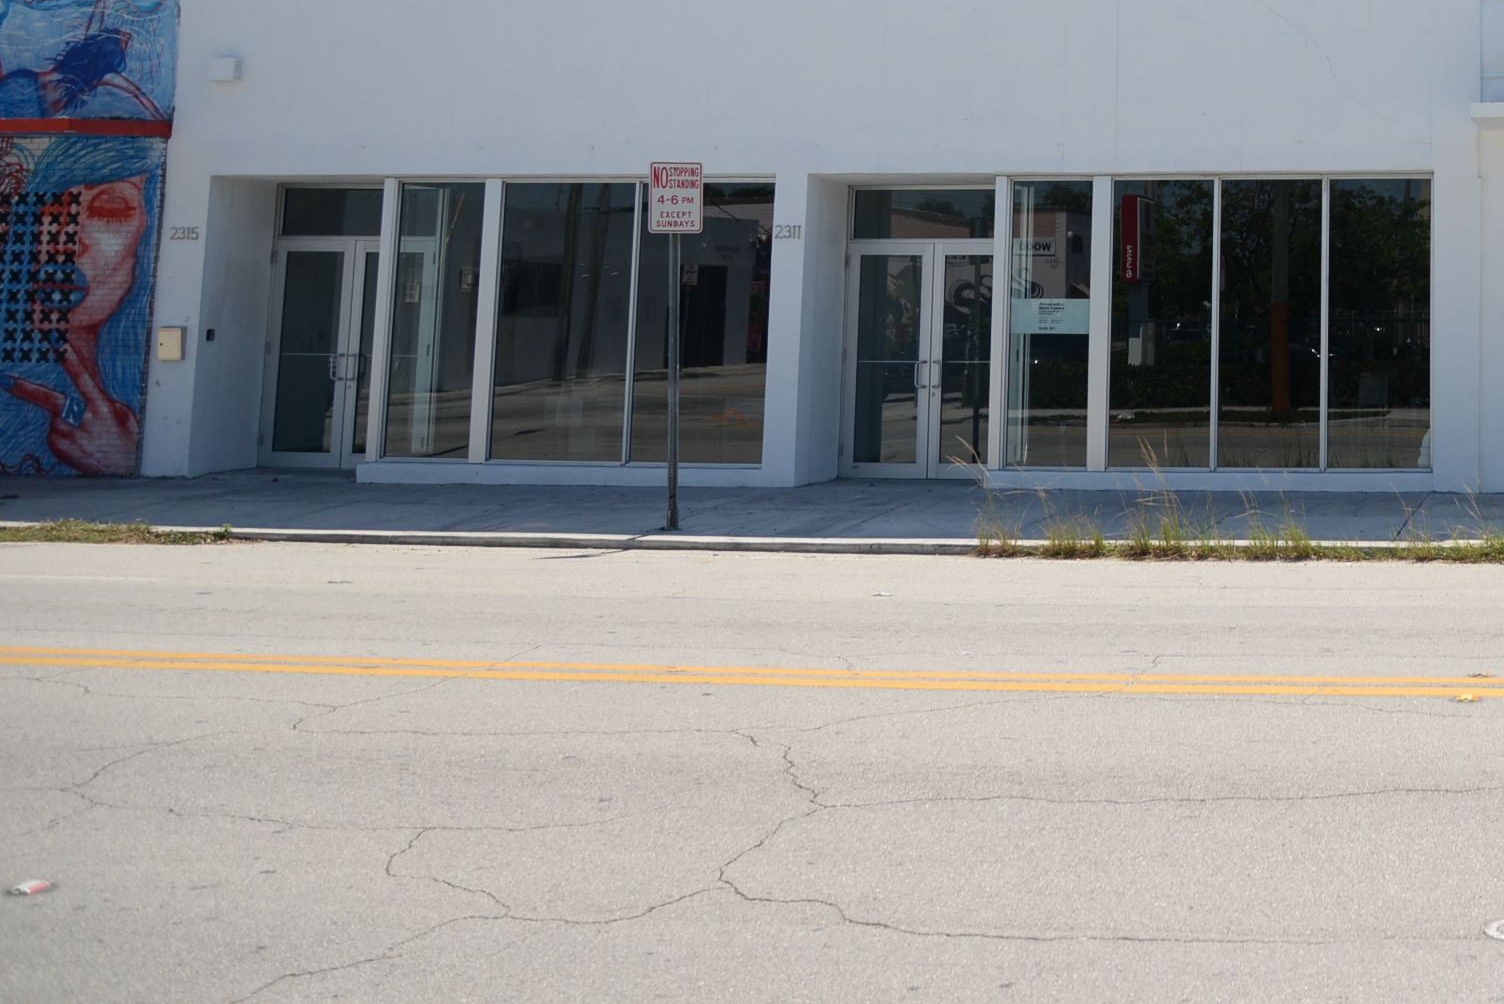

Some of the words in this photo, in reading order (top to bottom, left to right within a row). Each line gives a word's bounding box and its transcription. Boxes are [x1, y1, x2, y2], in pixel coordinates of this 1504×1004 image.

[653, 166, 668, 189] NO
[669, 167, 699, 177] STOPPING
[669, 179, 699, 189] STANDING
[657, 195, 679, 205] 4-6
[681, 196, 694, 204] PM
[660, 211, 692, 219] EXCEPT
[656, 220, 695, 228] SUNDAYS
[169, 226, 199, 241] 2315
[775, 224, 802, 239] 2311
